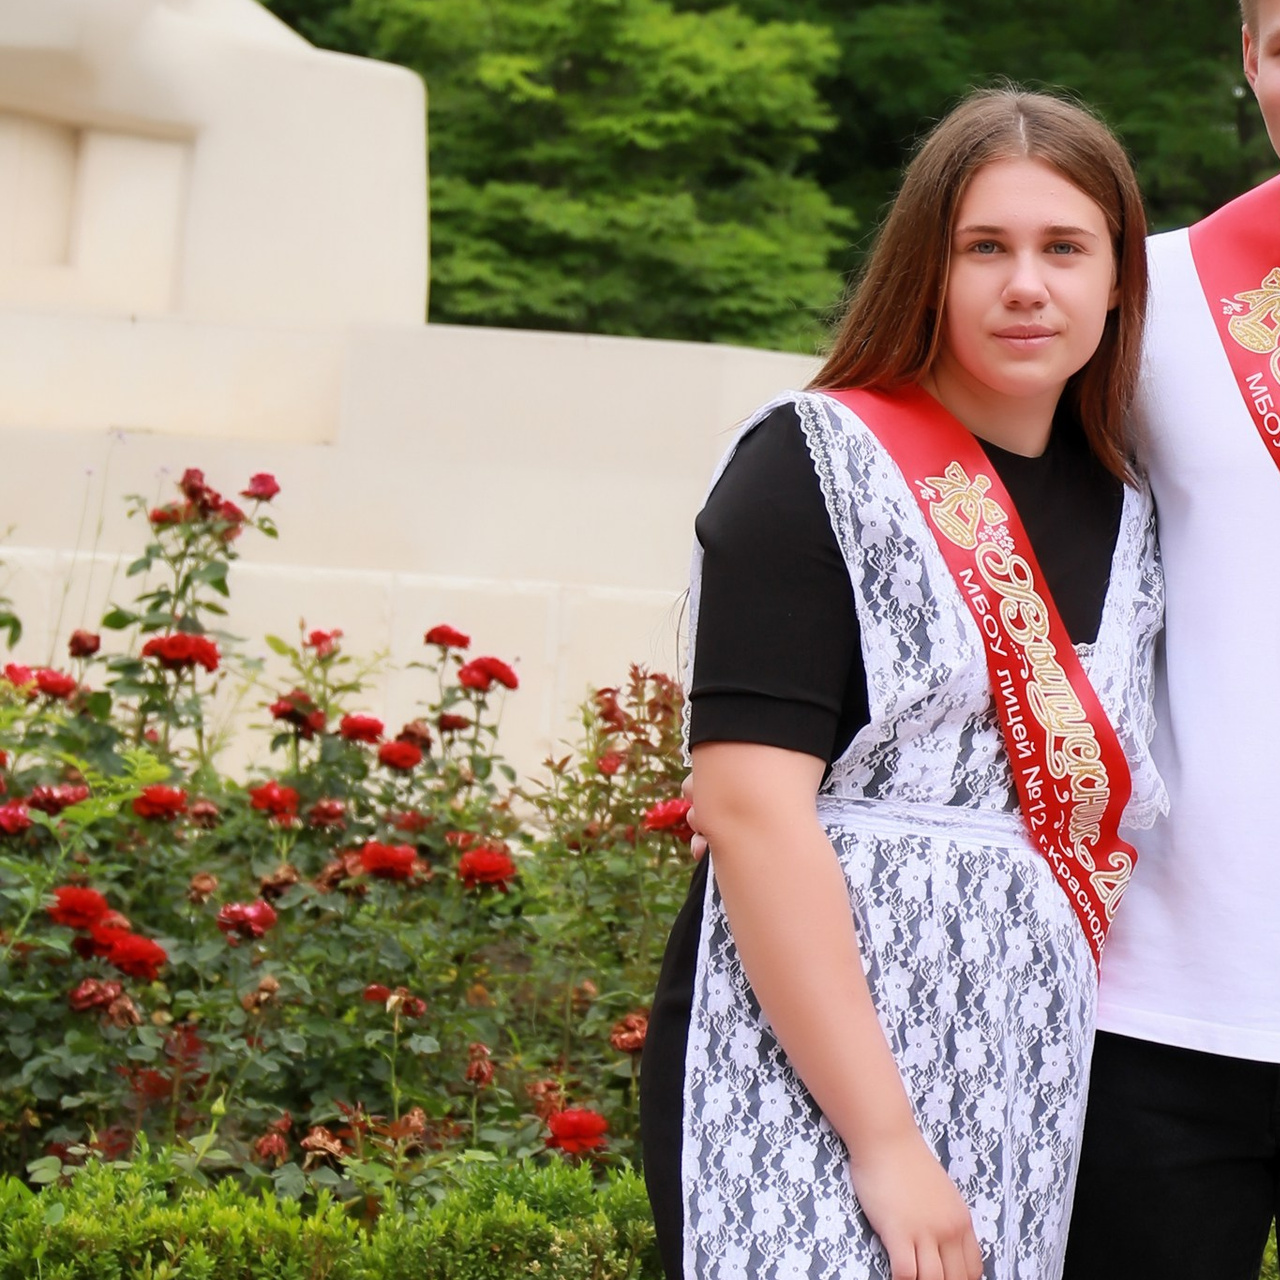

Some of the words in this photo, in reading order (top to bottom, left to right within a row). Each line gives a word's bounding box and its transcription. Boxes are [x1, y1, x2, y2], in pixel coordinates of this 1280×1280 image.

[959, 568, 1007, 657] МБОУ
[997, 668, 1036, 760] лицей
[1022, 765, 1047, 832] №12
[975, 541, 1110, 872] Выпускник
